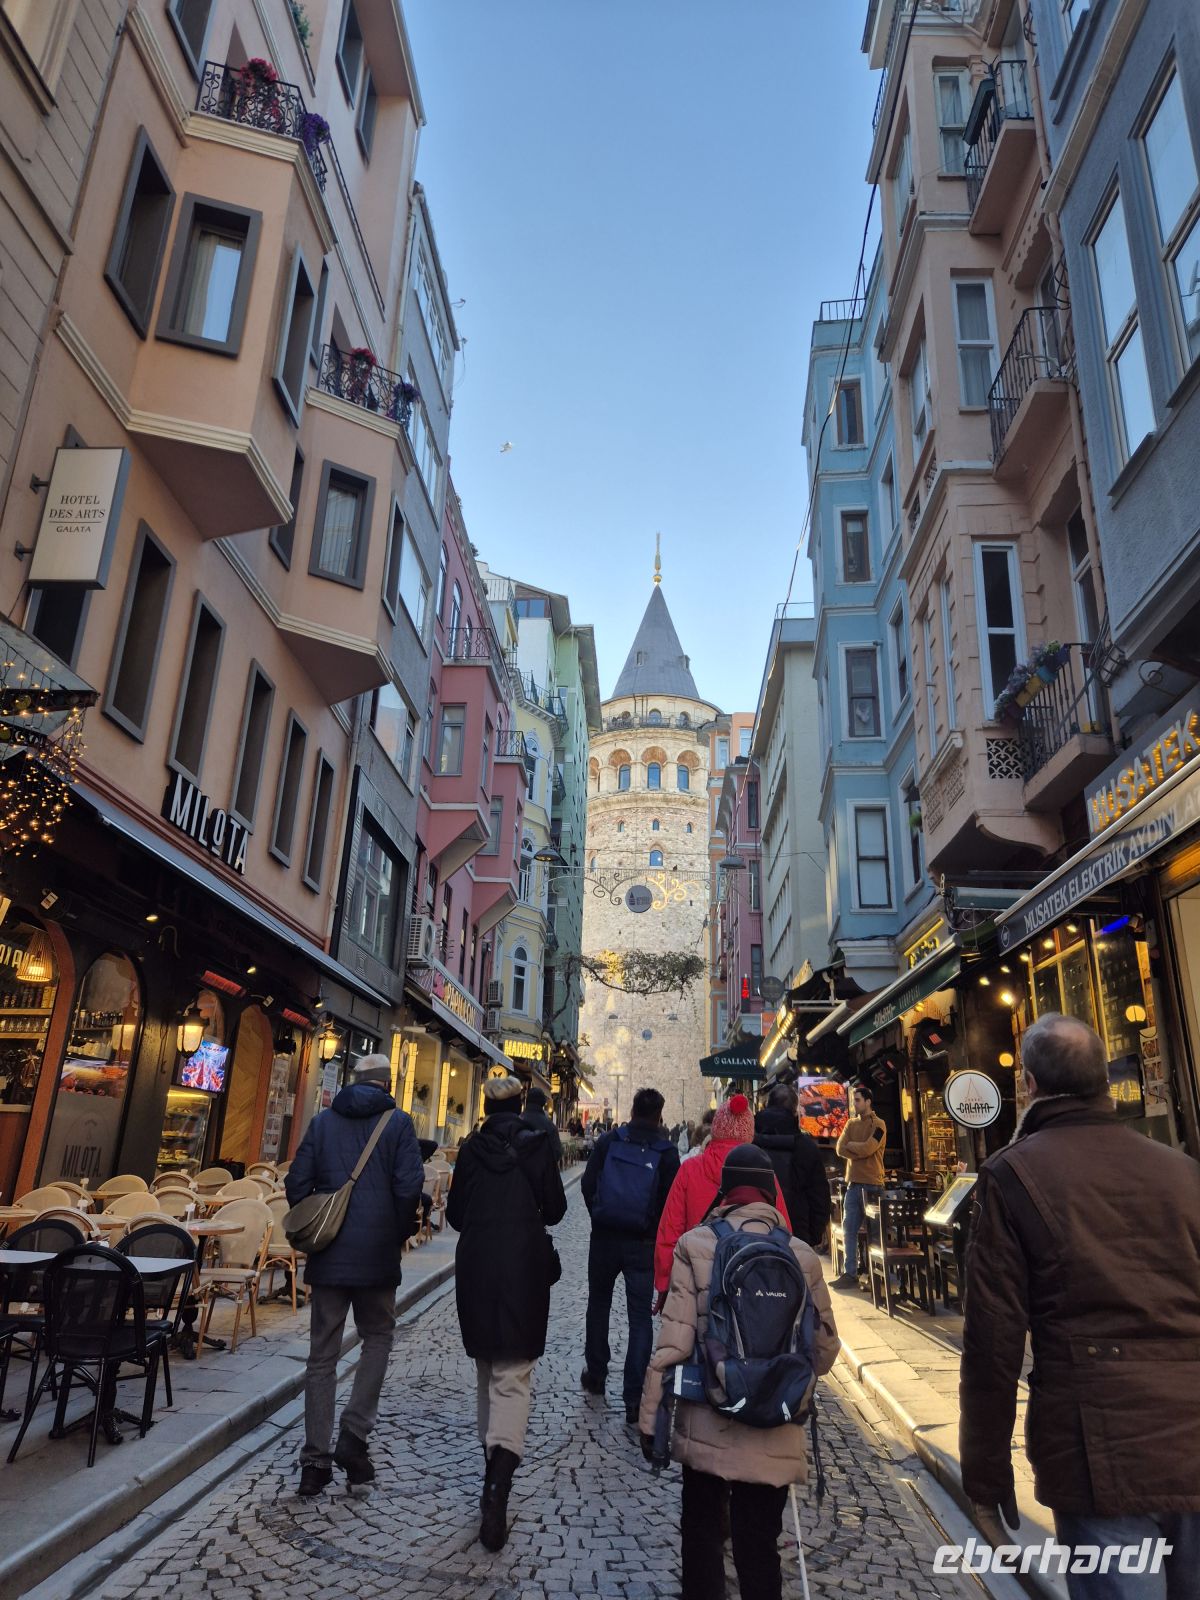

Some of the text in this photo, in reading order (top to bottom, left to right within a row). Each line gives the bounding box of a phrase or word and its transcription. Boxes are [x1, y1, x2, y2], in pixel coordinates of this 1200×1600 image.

[60, 495, 100, 505] HOTEL
[49, 509, 105, 519] DES ARTS
[1087, 708, 1200, 834] MUSATEK
[169, 773, 249, 875] MILOTA
[1023, 884, 1068, 934] MUSATEK
[1069, 843, 1127, 903] ELEKTRİK
[504, 1039, 543, 1061] MADDIE'S
[721, 1057, 758, 1066] GALLANT
